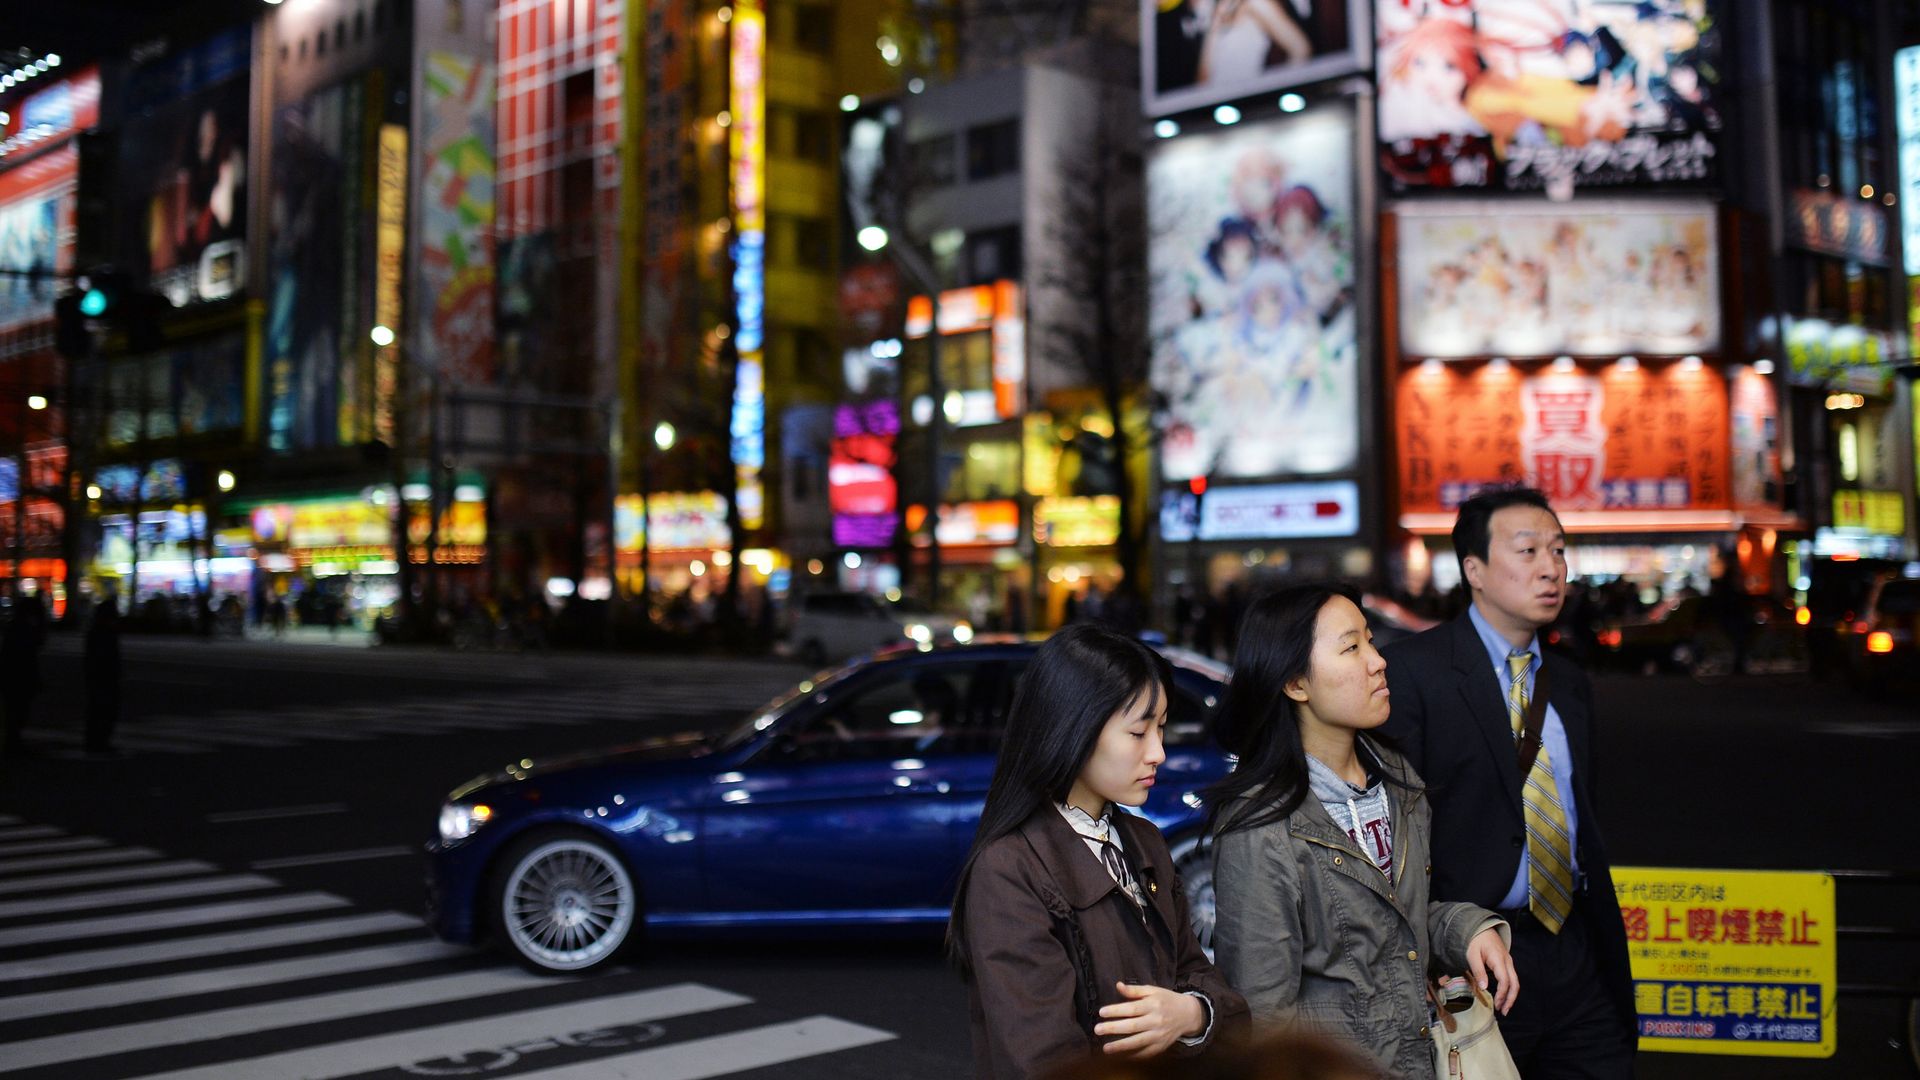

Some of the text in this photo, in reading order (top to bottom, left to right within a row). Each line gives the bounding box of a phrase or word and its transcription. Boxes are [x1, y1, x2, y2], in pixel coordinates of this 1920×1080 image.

[1532, 388, 1600, 503] 買取
[1614, 882, 1726, 902] 千代田区内は
